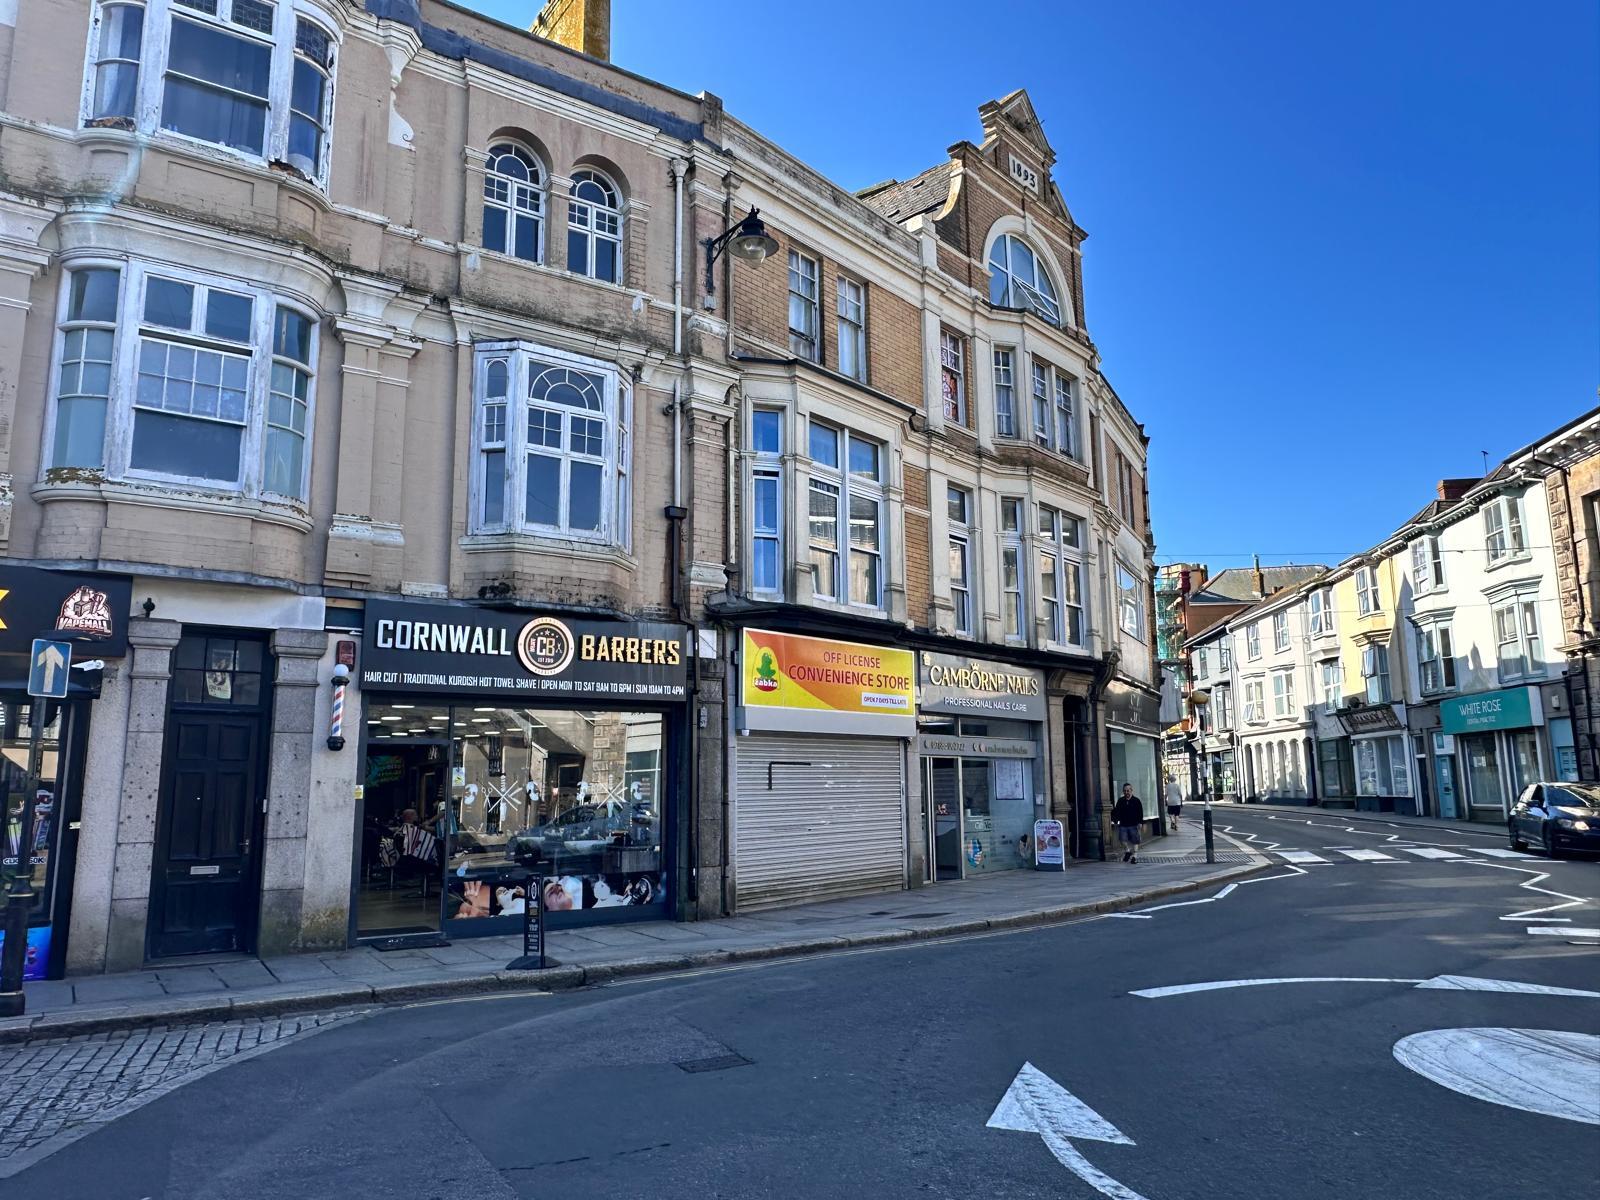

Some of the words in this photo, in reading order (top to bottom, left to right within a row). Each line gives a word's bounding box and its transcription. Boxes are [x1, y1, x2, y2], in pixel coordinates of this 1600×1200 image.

[1012, 159, 1036, 188] 1893
[57, 617, 111, 633] VAPEMALL
[377, 619, 511, 656] CORNWALL
[581, 634, 681, 665] BARBERS
[823, 651, 842, 664] OFF
[844, 654, 881, 669] LICENSE
[364, 671, 382, 682] HAIR
[383, 672, 398, 683] CUT
[403, 673, 447, 685] TRADITIONAL
[478, 676, 492, 687] HOT
[493, 677, 515, 688] TOWEL
[515, 679, 537, 689] SHAVE
[541, 680, 558, 690] OPEN
[559, 681, 573, 690] MON
[574, 681, 583, 690] TO
[583, 681, 595, 691] SAT
[596, 682, 609, 692] 9AM
[609, 683, 618, 692] TO
[619, 683, 632, 693] 6PM
[635, 684, 648, 693] SUN
[648, 685, 663, 694] 10AM
[663, 685, 671, 694] TO
[671, 686, 684, 695] 4PM
[788, 665, 874, 687] CONVENIENCE
[876, 674, 910, 690] STORE
[930, 665, 1004, 692] CAMBORNE
[1006, 674, 1039, 696] NAILS
[944, 697, 993, 709] PROFESSIONAL
[993, 702, 1010, 710] NAILS
[1011, 703, 1027, 712] CARE
[1459, 703, 1481, 715] WHITE
[1482, 699, 1501, 712] ROSE
